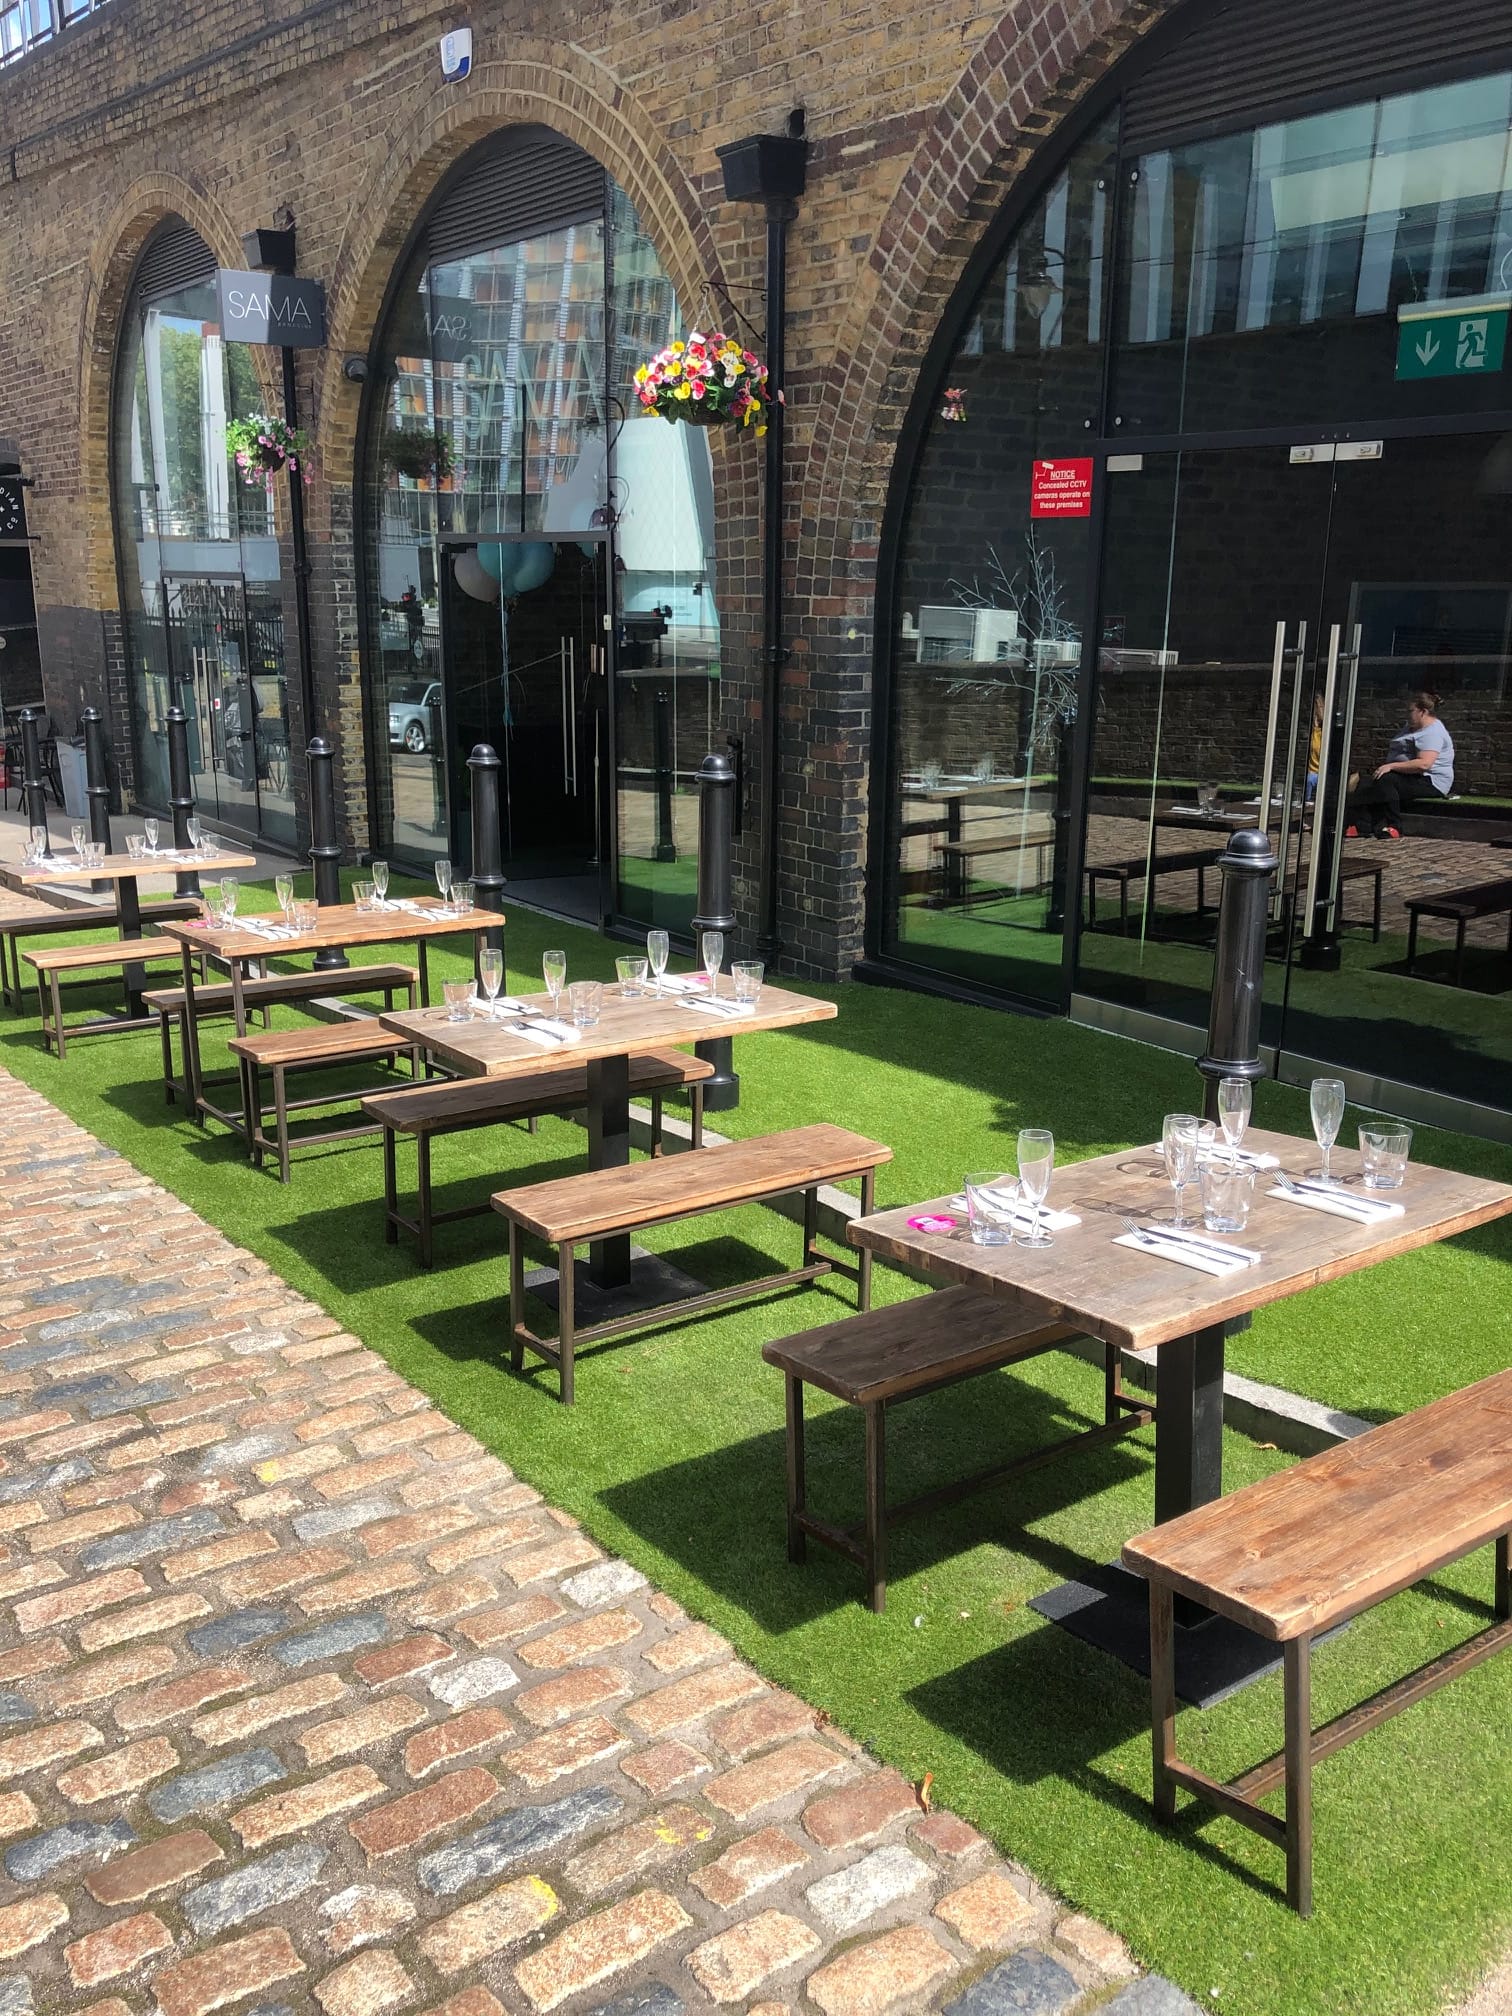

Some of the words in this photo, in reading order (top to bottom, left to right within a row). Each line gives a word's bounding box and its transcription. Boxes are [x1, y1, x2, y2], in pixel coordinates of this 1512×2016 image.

[228, 290, 312, 324] SAMA
[461, 336, 606, 440] SAMA
[1050, 470, 1076, 480] NOTICE
[1038, 481, 1069, 489] Concealed
[1070, 480, 1087, 488] CCTV
[1059, 491, 1081, 500] operate
[1056, 501, 1083, 510] premises
